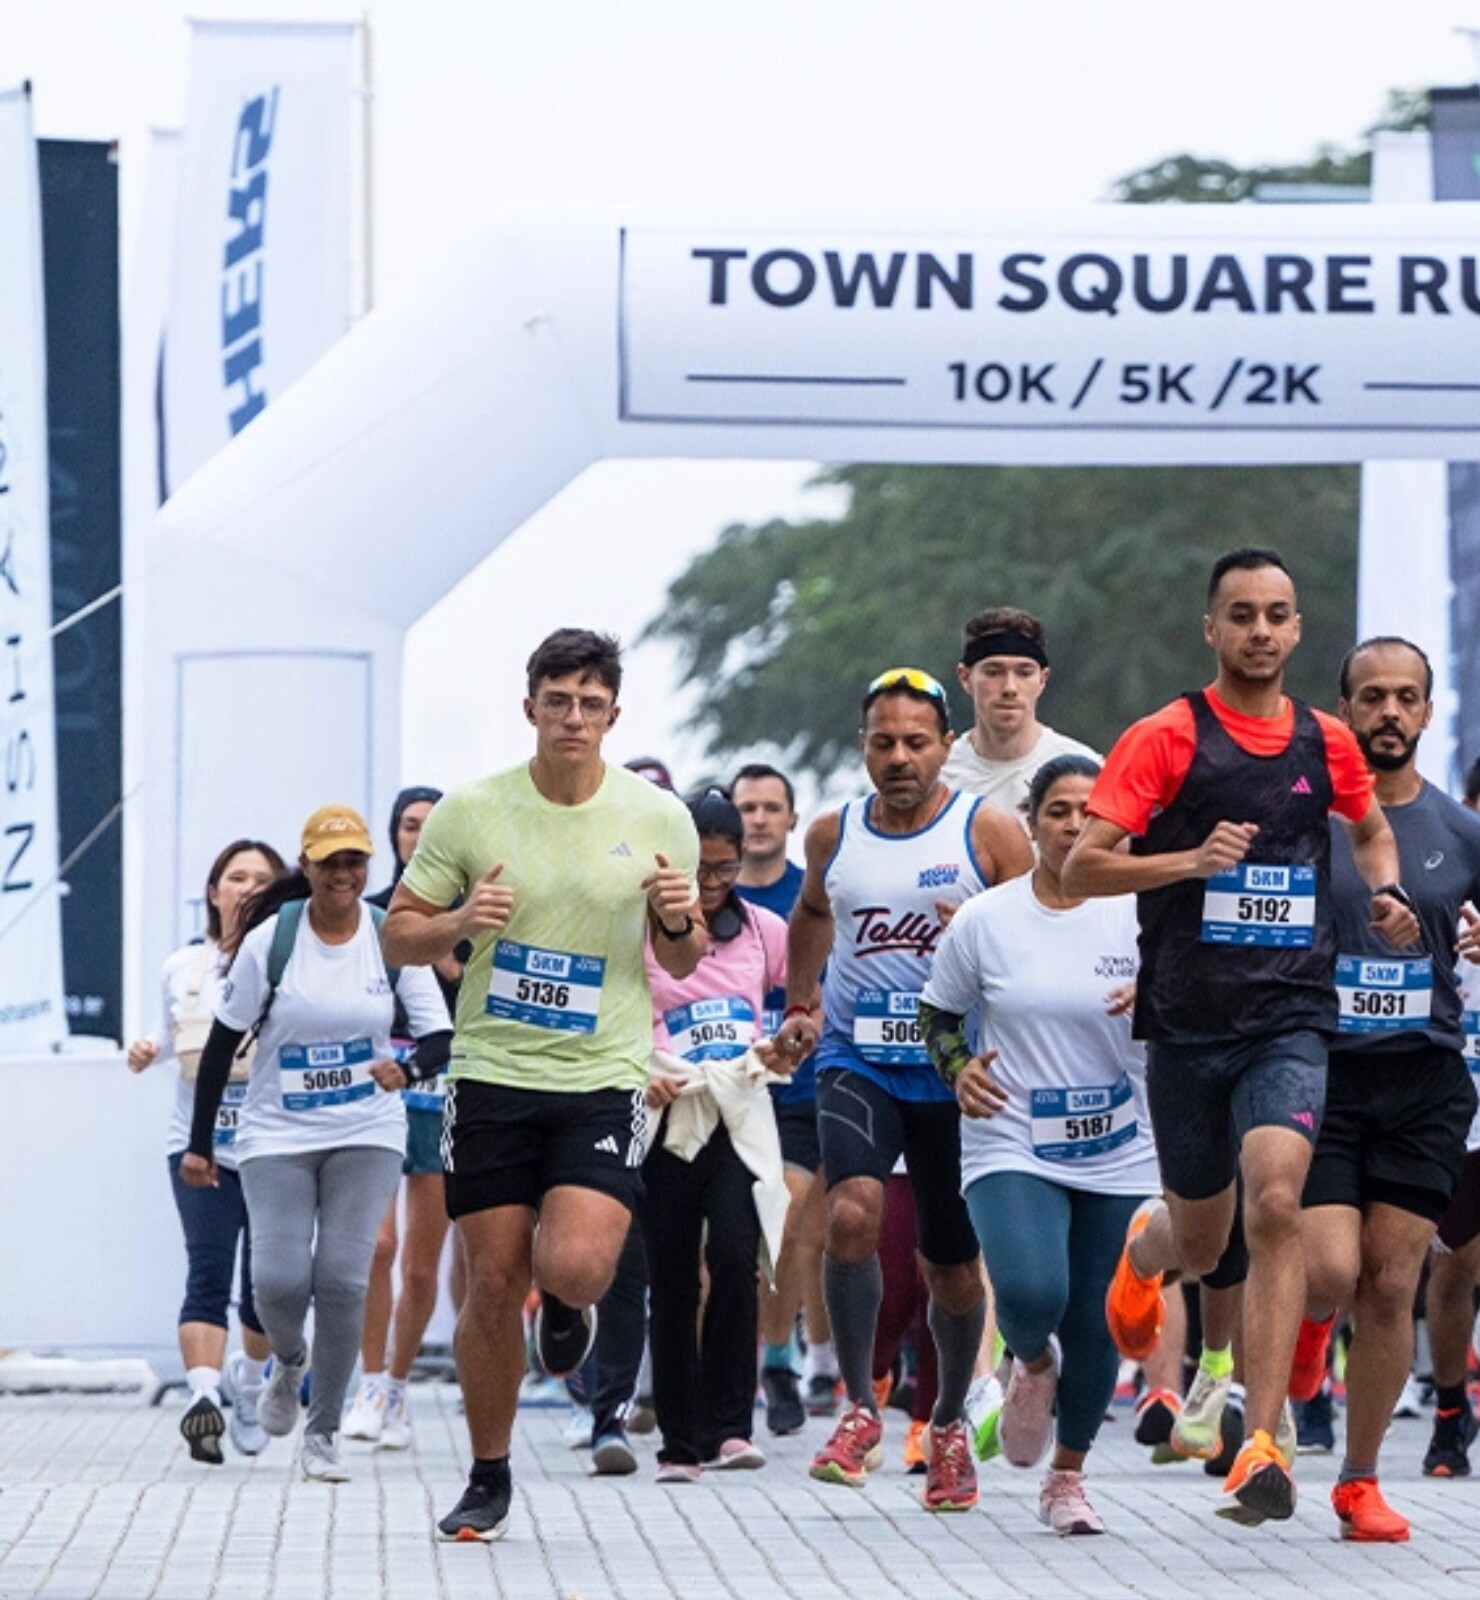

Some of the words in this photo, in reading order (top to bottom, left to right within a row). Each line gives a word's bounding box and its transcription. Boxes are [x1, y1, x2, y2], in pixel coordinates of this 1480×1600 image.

[692, 249, 974, 311] TOWN
[998, 252, 1375, 318] SQUARE
[948, 362, 1054, 405] 10K
[1119, 362, 1195, 404] 5K
[1252, 870, 1285, 886] 5KM
[1238, 897, 1291, 922] 5192
[852, 908, 941, 957] Tally
[531, 955, 566, 973] 5KM
[1367, 966, 1399, 981] 5KM
[516, 978, 570, 1008] 5136
[1353, 992, 1406, 1015] 5031
[691, 1023, 737, 1045] 5045
[311, 1047, 340, 1062] 5KM
[303, 1068, 352, 1090] 5060
[1072, 1092, 1105, 1109] 5KM
[1065, 1115, 1114, 1140] 5187
